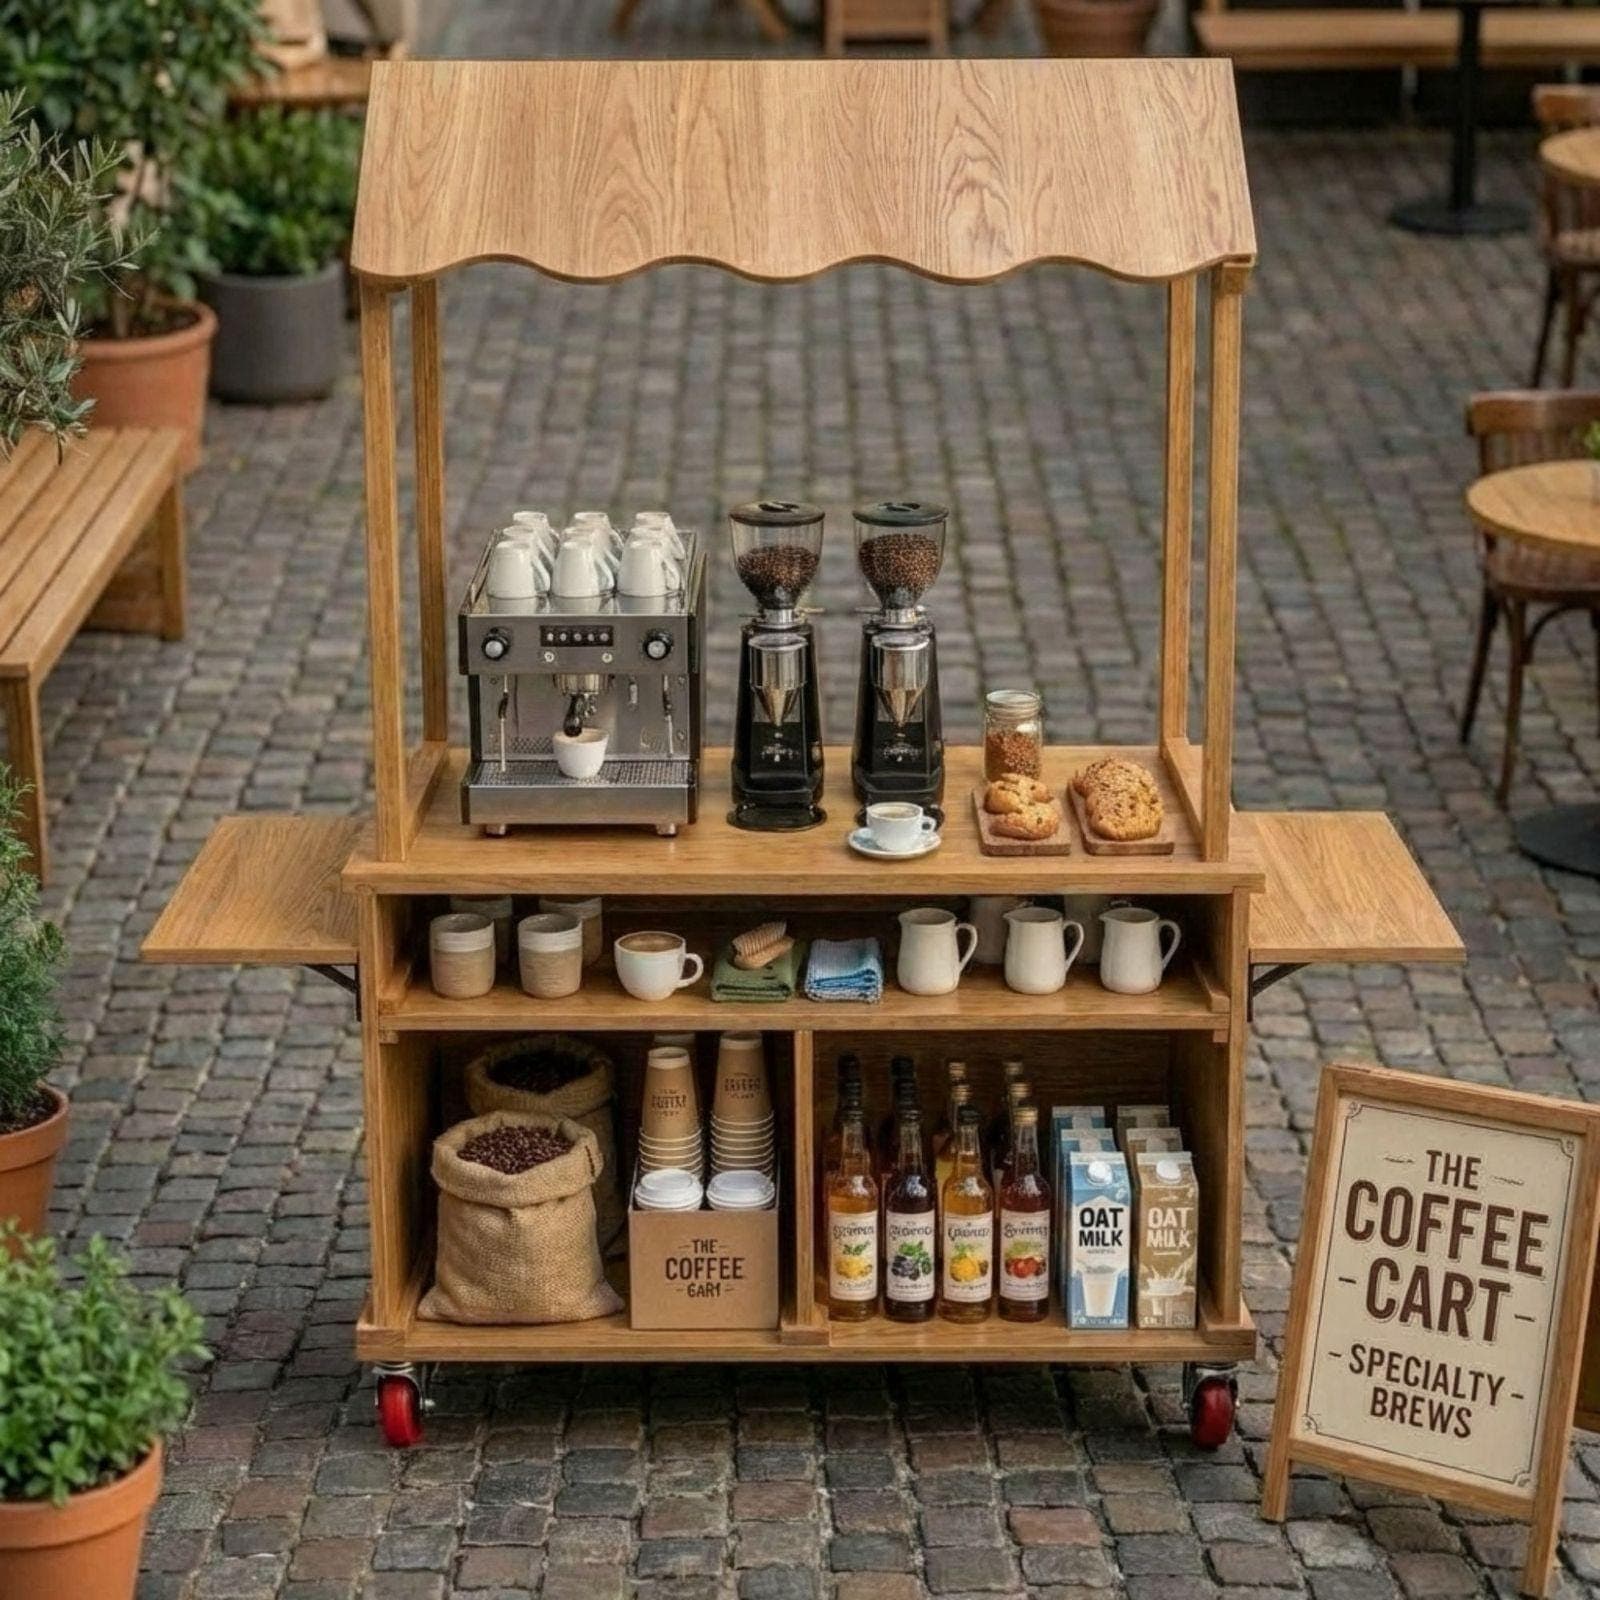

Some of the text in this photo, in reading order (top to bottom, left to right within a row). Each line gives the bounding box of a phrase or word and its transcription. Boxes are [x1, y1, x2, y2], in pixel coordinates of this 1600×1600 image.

[1426, 1149, 1482, 1190] THE
[1080, 1207, 1124, 1229] OAT
[1147, 1207, 1194, 1229] OAT
[1344, 1179, 1549, 1278] COFFEE
[692, 1239, 718, 1254] THE
[1079, 1229, 1123, 1247] MILK
[665, 1257, 745, 1281] COFFEE
[1364, 1257, 1512, 1343] CART
[1349, 1343, 1506, 1407] SPECIALTY
[1370, 1387, 1473, 1438] BREWS
